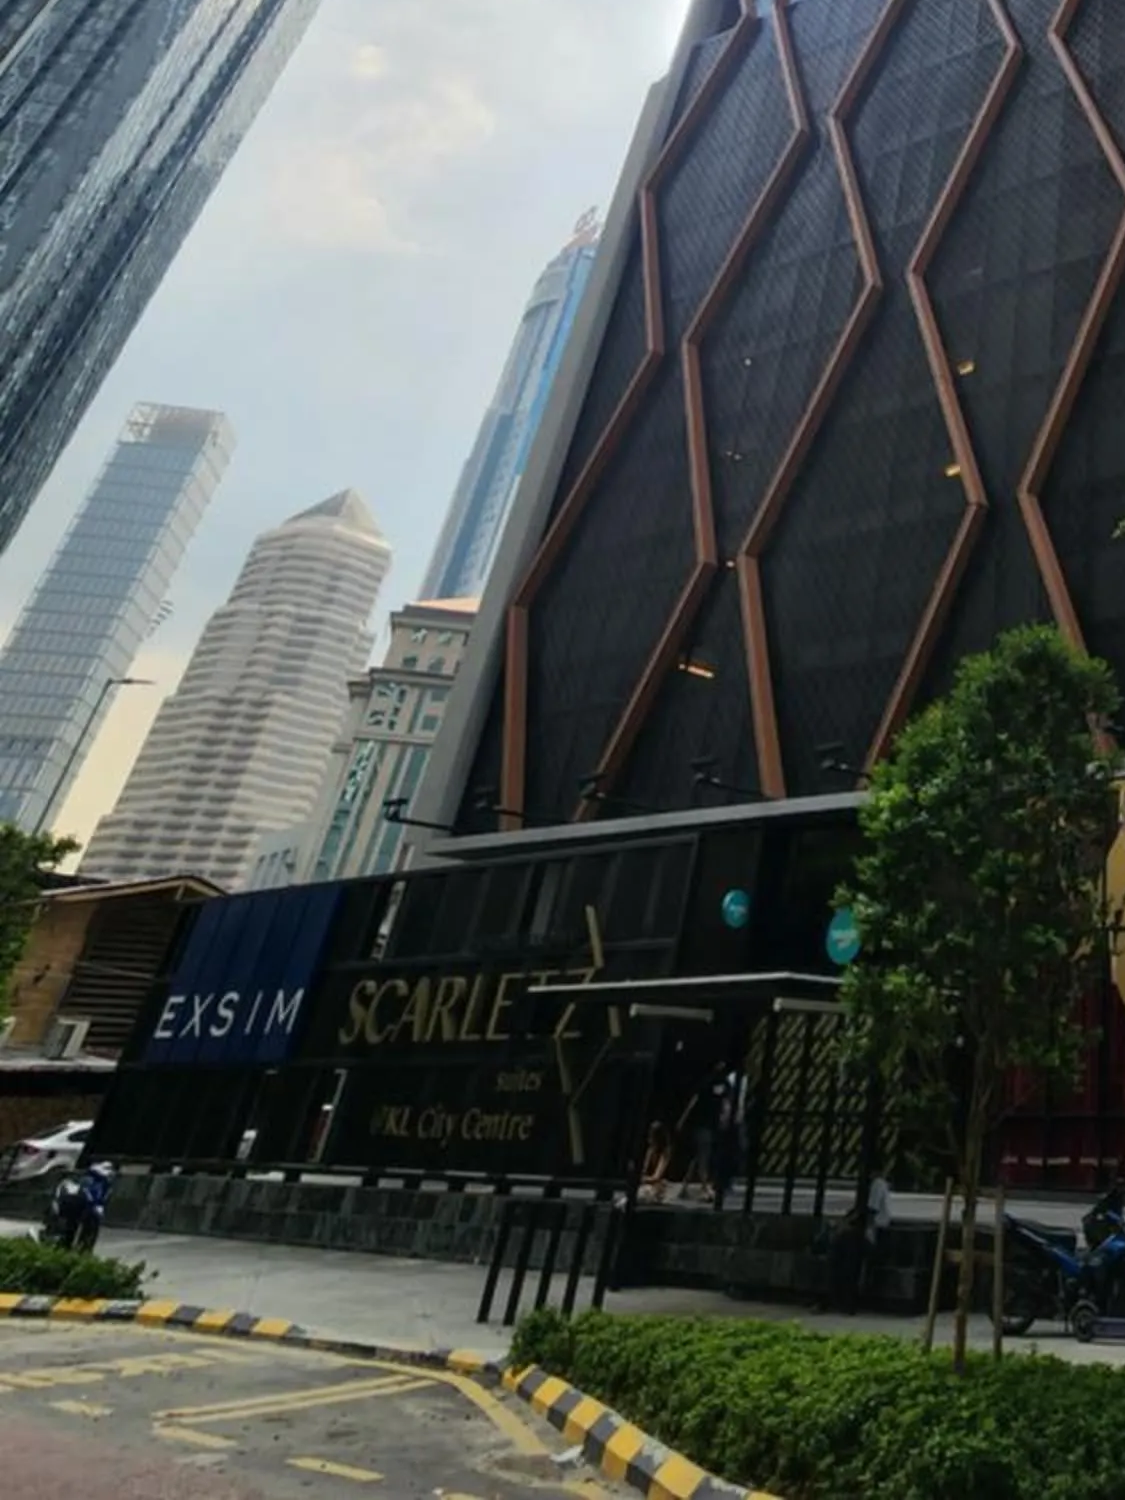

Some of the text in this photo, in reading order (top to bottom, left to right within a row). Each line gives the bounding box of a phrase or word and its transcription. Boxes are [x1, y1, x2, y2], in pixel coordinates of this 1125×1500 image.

[153, 987, 306, 1040] EXSIM
[417, 1102, 457, 1152] City
[461, 1106, 536, 1141] Centre
